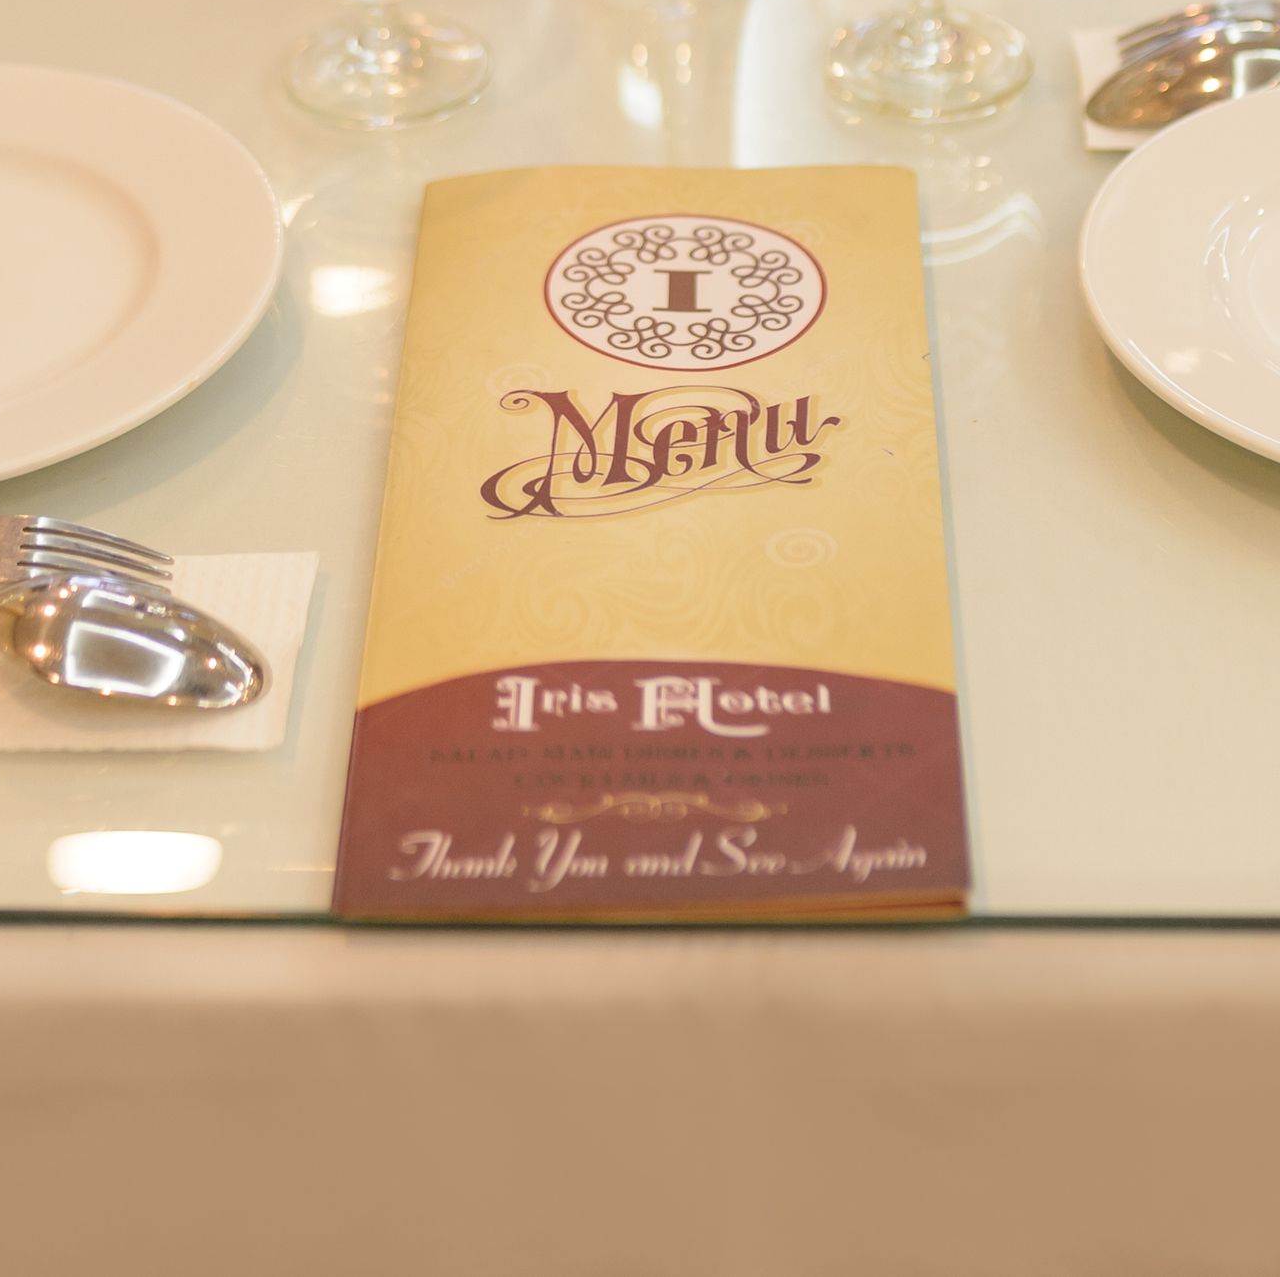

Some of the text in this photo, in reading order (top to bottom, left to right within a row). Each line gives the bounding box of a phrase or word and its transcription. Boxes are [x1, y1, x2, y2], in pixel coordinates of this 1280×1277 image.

[652, 269, 713, 313] I
[480, 384, 842, 521] Menu
[492, 675, 832, 738] Iris Hotel
[388, 823, 927, 893] Thank You and See Again
